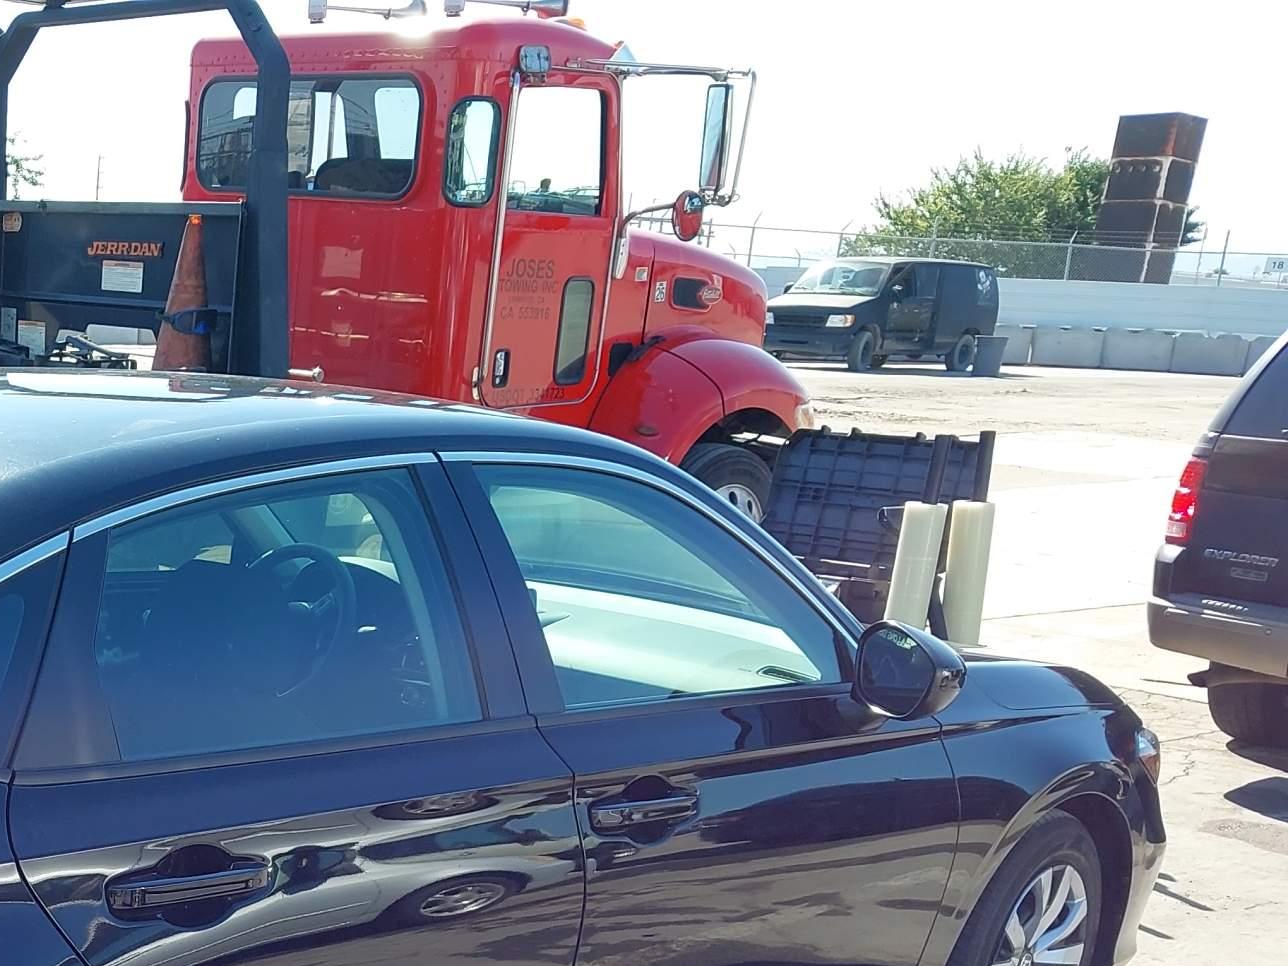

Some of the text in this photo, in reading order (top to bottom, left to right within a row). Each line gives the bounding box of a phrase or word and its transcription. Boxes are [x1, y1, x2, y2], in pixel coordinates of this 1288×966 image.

[506, 258, 554, 279] JOSES
[1272, 261, 1284, 270] 18
[499, 279, 559, 294] TOWING INC
[655, 286, 666, 301] 26
[1204, 548, 1280, 567] EXPLORER
